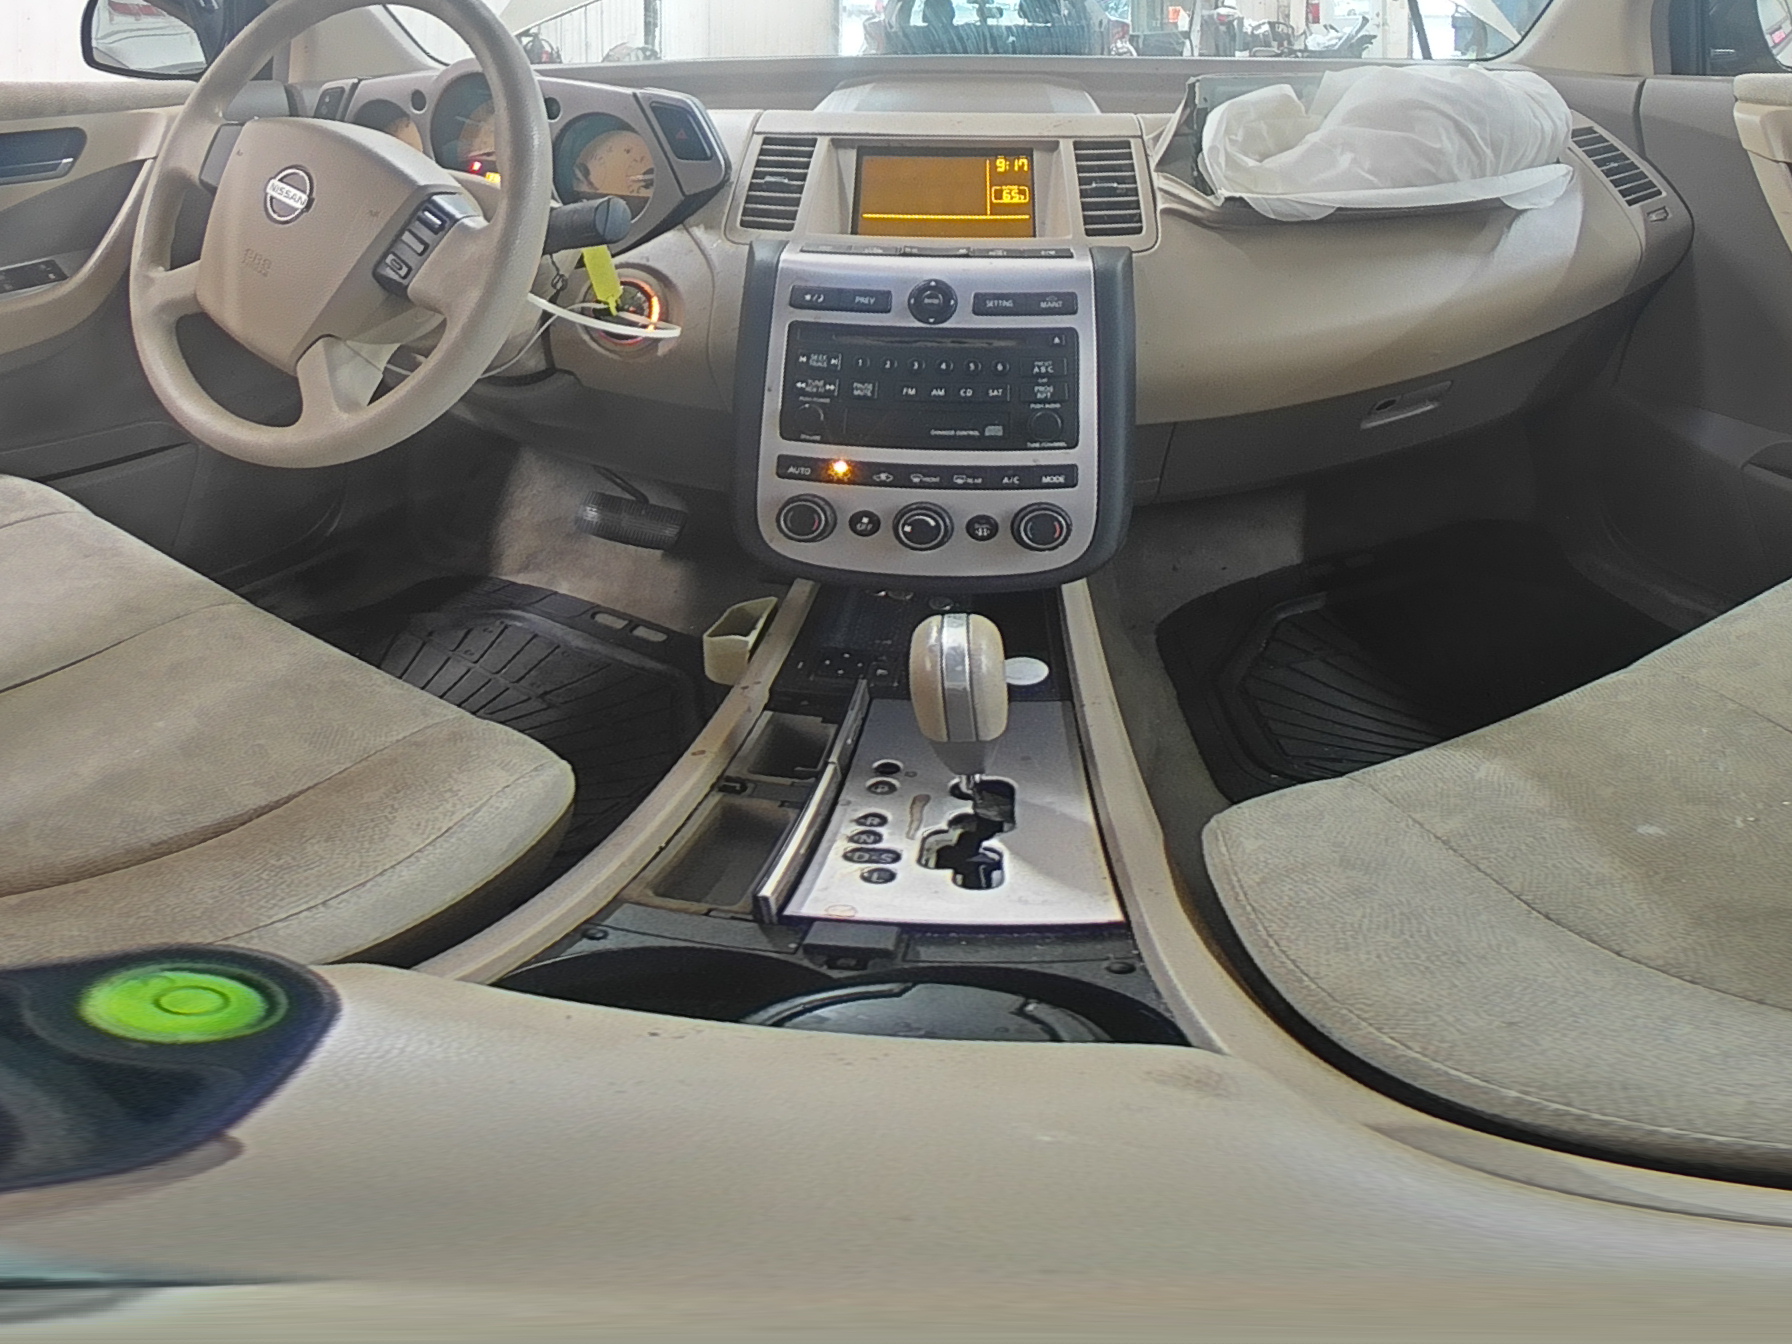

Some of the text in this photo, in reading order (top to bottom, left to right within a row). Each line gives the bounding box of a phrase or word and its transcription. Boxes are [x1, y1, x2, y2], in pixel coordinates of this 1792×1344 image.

[269, 182, 308, 206] NISSAN
[986, 300, 1014, 308] SETTING
[902, 387, 916, 396] FM
[931, 388, 946, 397] AM
[960, 389, 973, 397] CD
[988, 389, 1003, 397] SAT
[788, 466, 811, 476] AUTO
[1002, 476, 1020, 484] A/C
[1041, 475, 1066, 484] MODE
